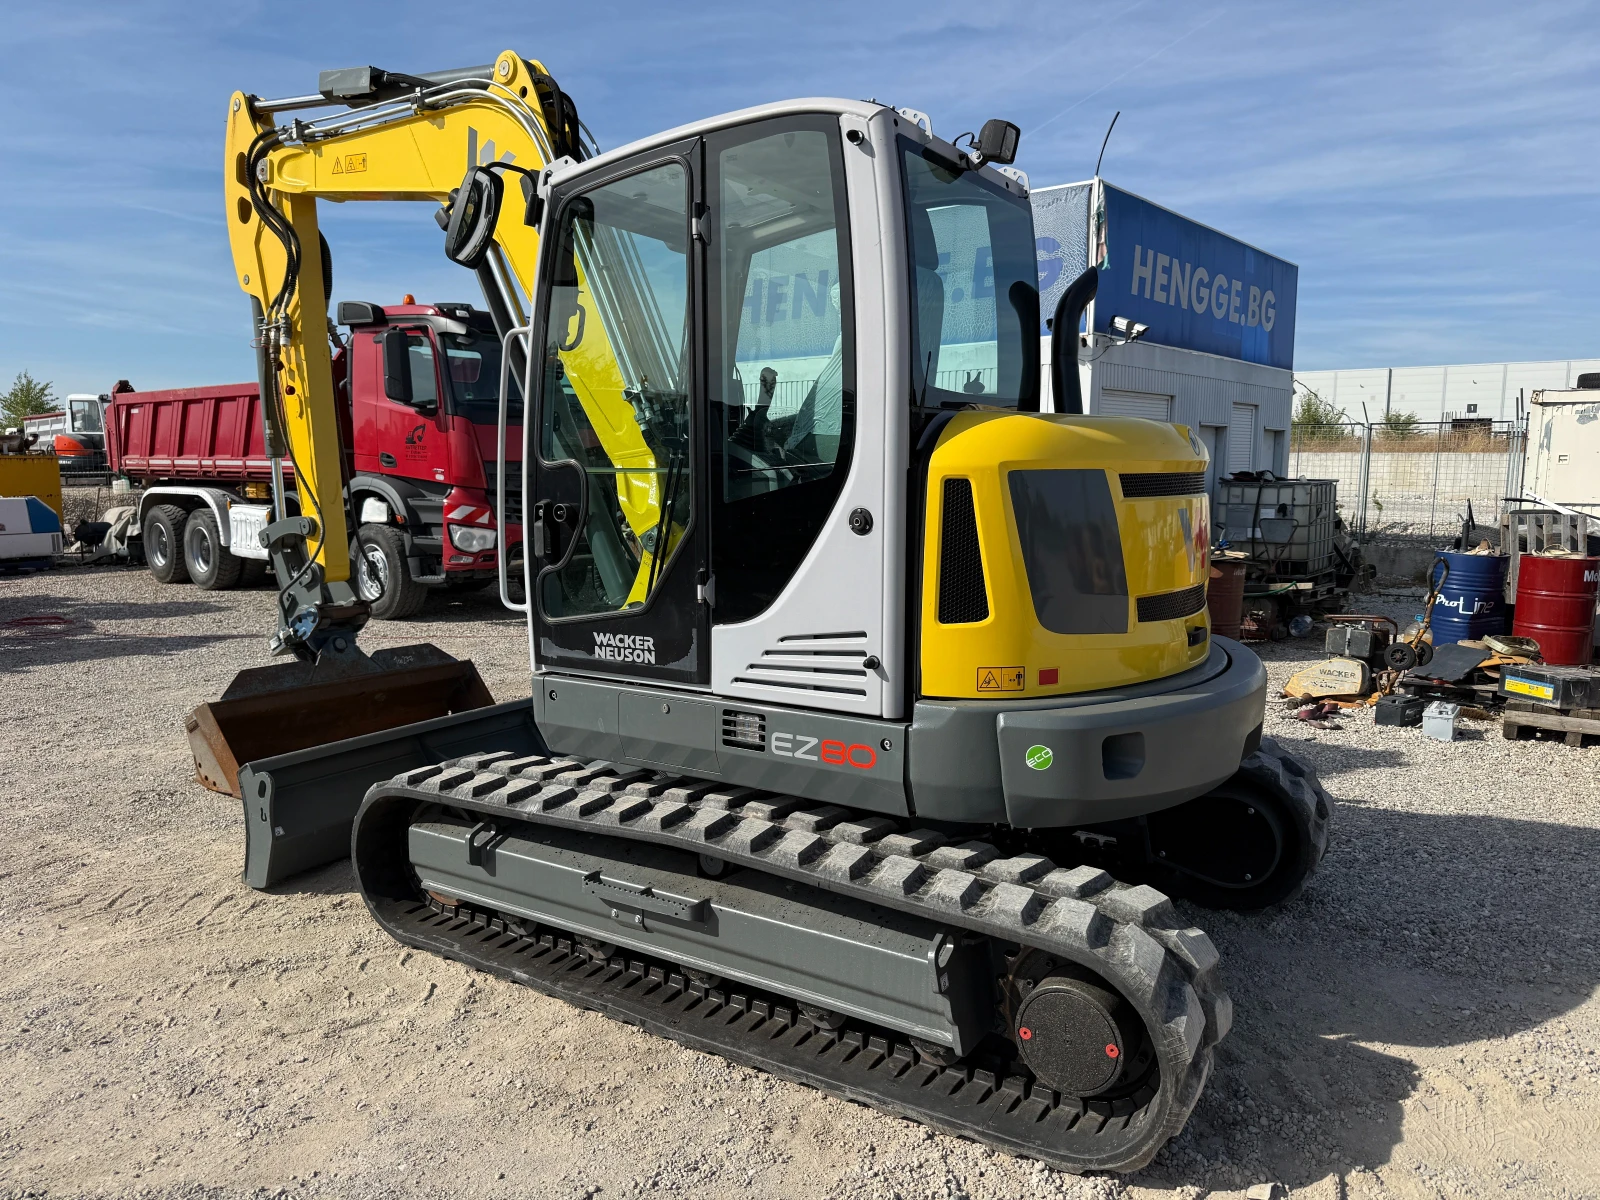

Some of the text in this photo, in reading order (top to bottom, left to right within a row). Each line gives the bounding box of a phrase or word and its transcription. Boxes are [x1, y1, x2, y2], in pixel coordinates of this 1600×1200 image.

[1131, 245, 1276, 332] HENGGE.BG
[1584, 570, 1600, 582] Mo
[593, 632, 655, 652] WACKER
[594, 645, 656, 665] NEUSON
[1319, 669, 1356, 679] WACKER
[771, 732, 877, 769] EZ80
